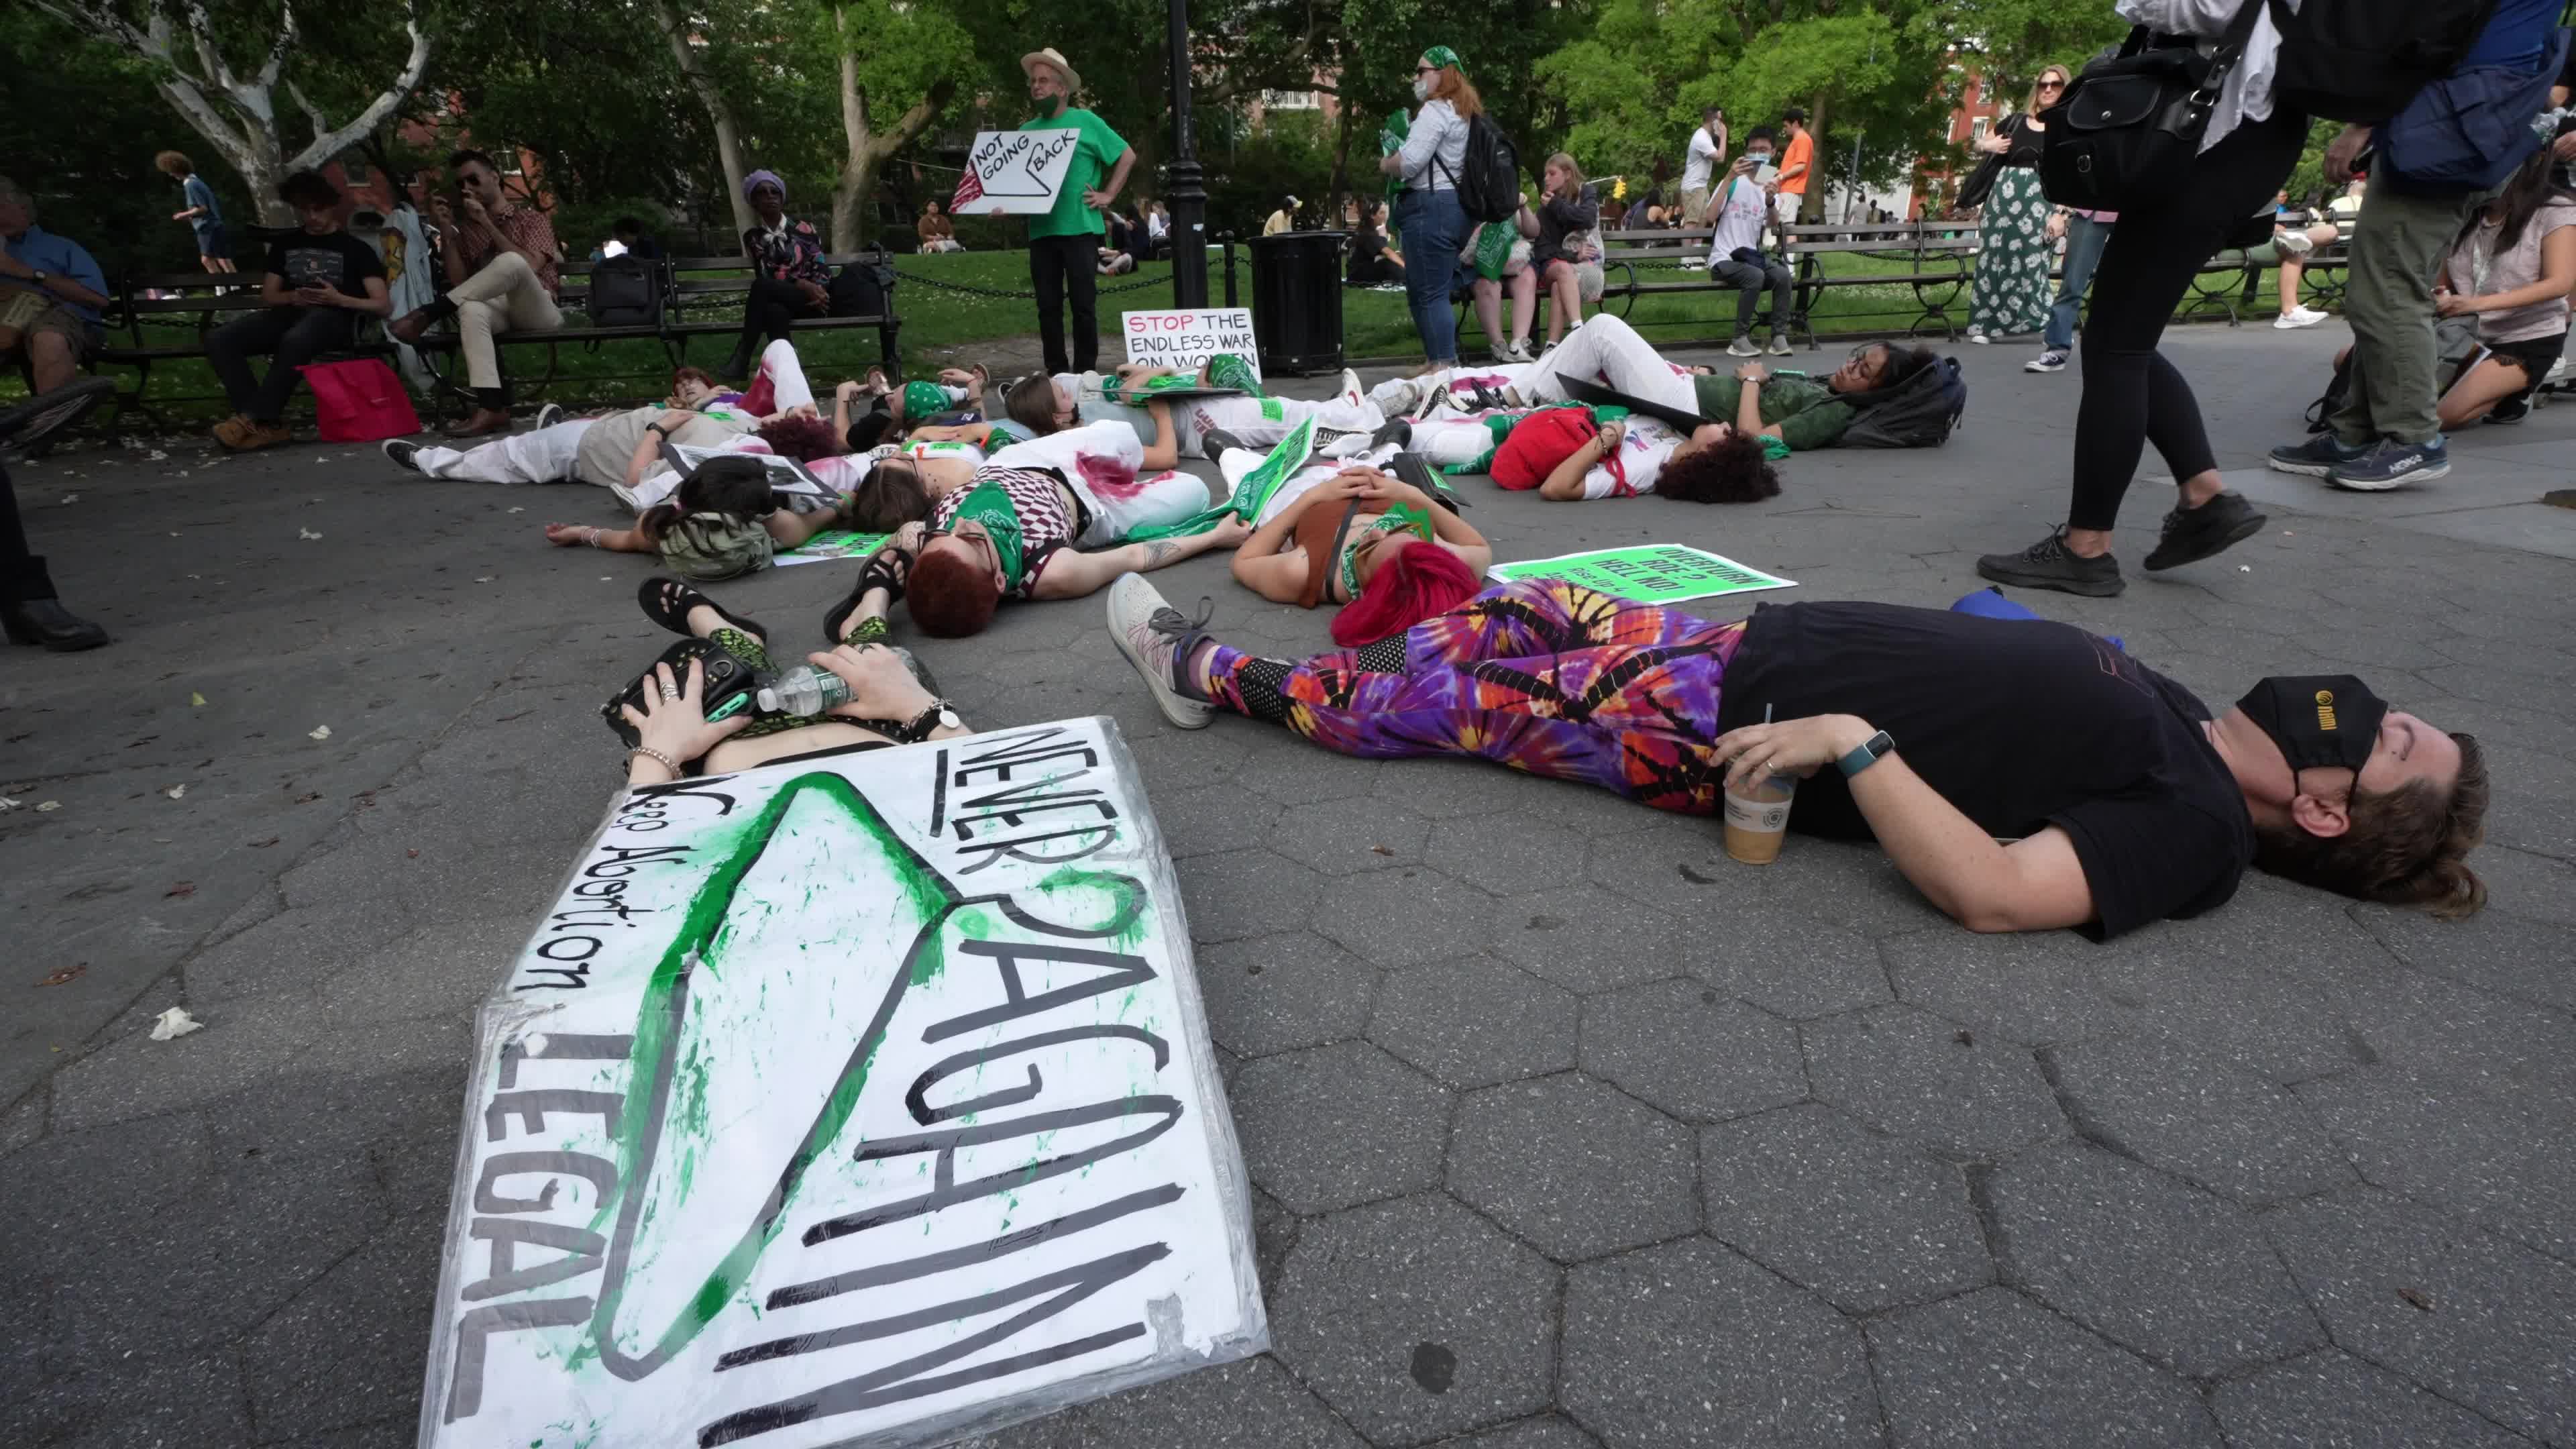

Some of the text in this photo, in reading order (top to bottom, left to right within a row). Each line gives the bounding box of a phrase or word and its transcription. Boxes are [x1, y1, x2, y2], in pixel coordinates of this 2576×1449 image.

[975, 132, 1004, 166] NOT
[982, 134, 1030, 180] GOING
[1033, 129, 1076, 172] BACK
[1128, 313, 1248, 333] STOP THE
[1130, 333, 1255, 353] ENDLESS WAR
[1136, 352, 1256, 369] ON WON
[1568, 567, 1597, 580] Rise
[1591, 558, 1648, 578] HELL
[1631, 576, 1686, 592] NO!
[1655, 549, 1766, 585] OVERTURN
[443, 775, 739, 1426] Keep Abortion LEGAL
[696, 727, 1186, 1449] NEVER AGAIN
